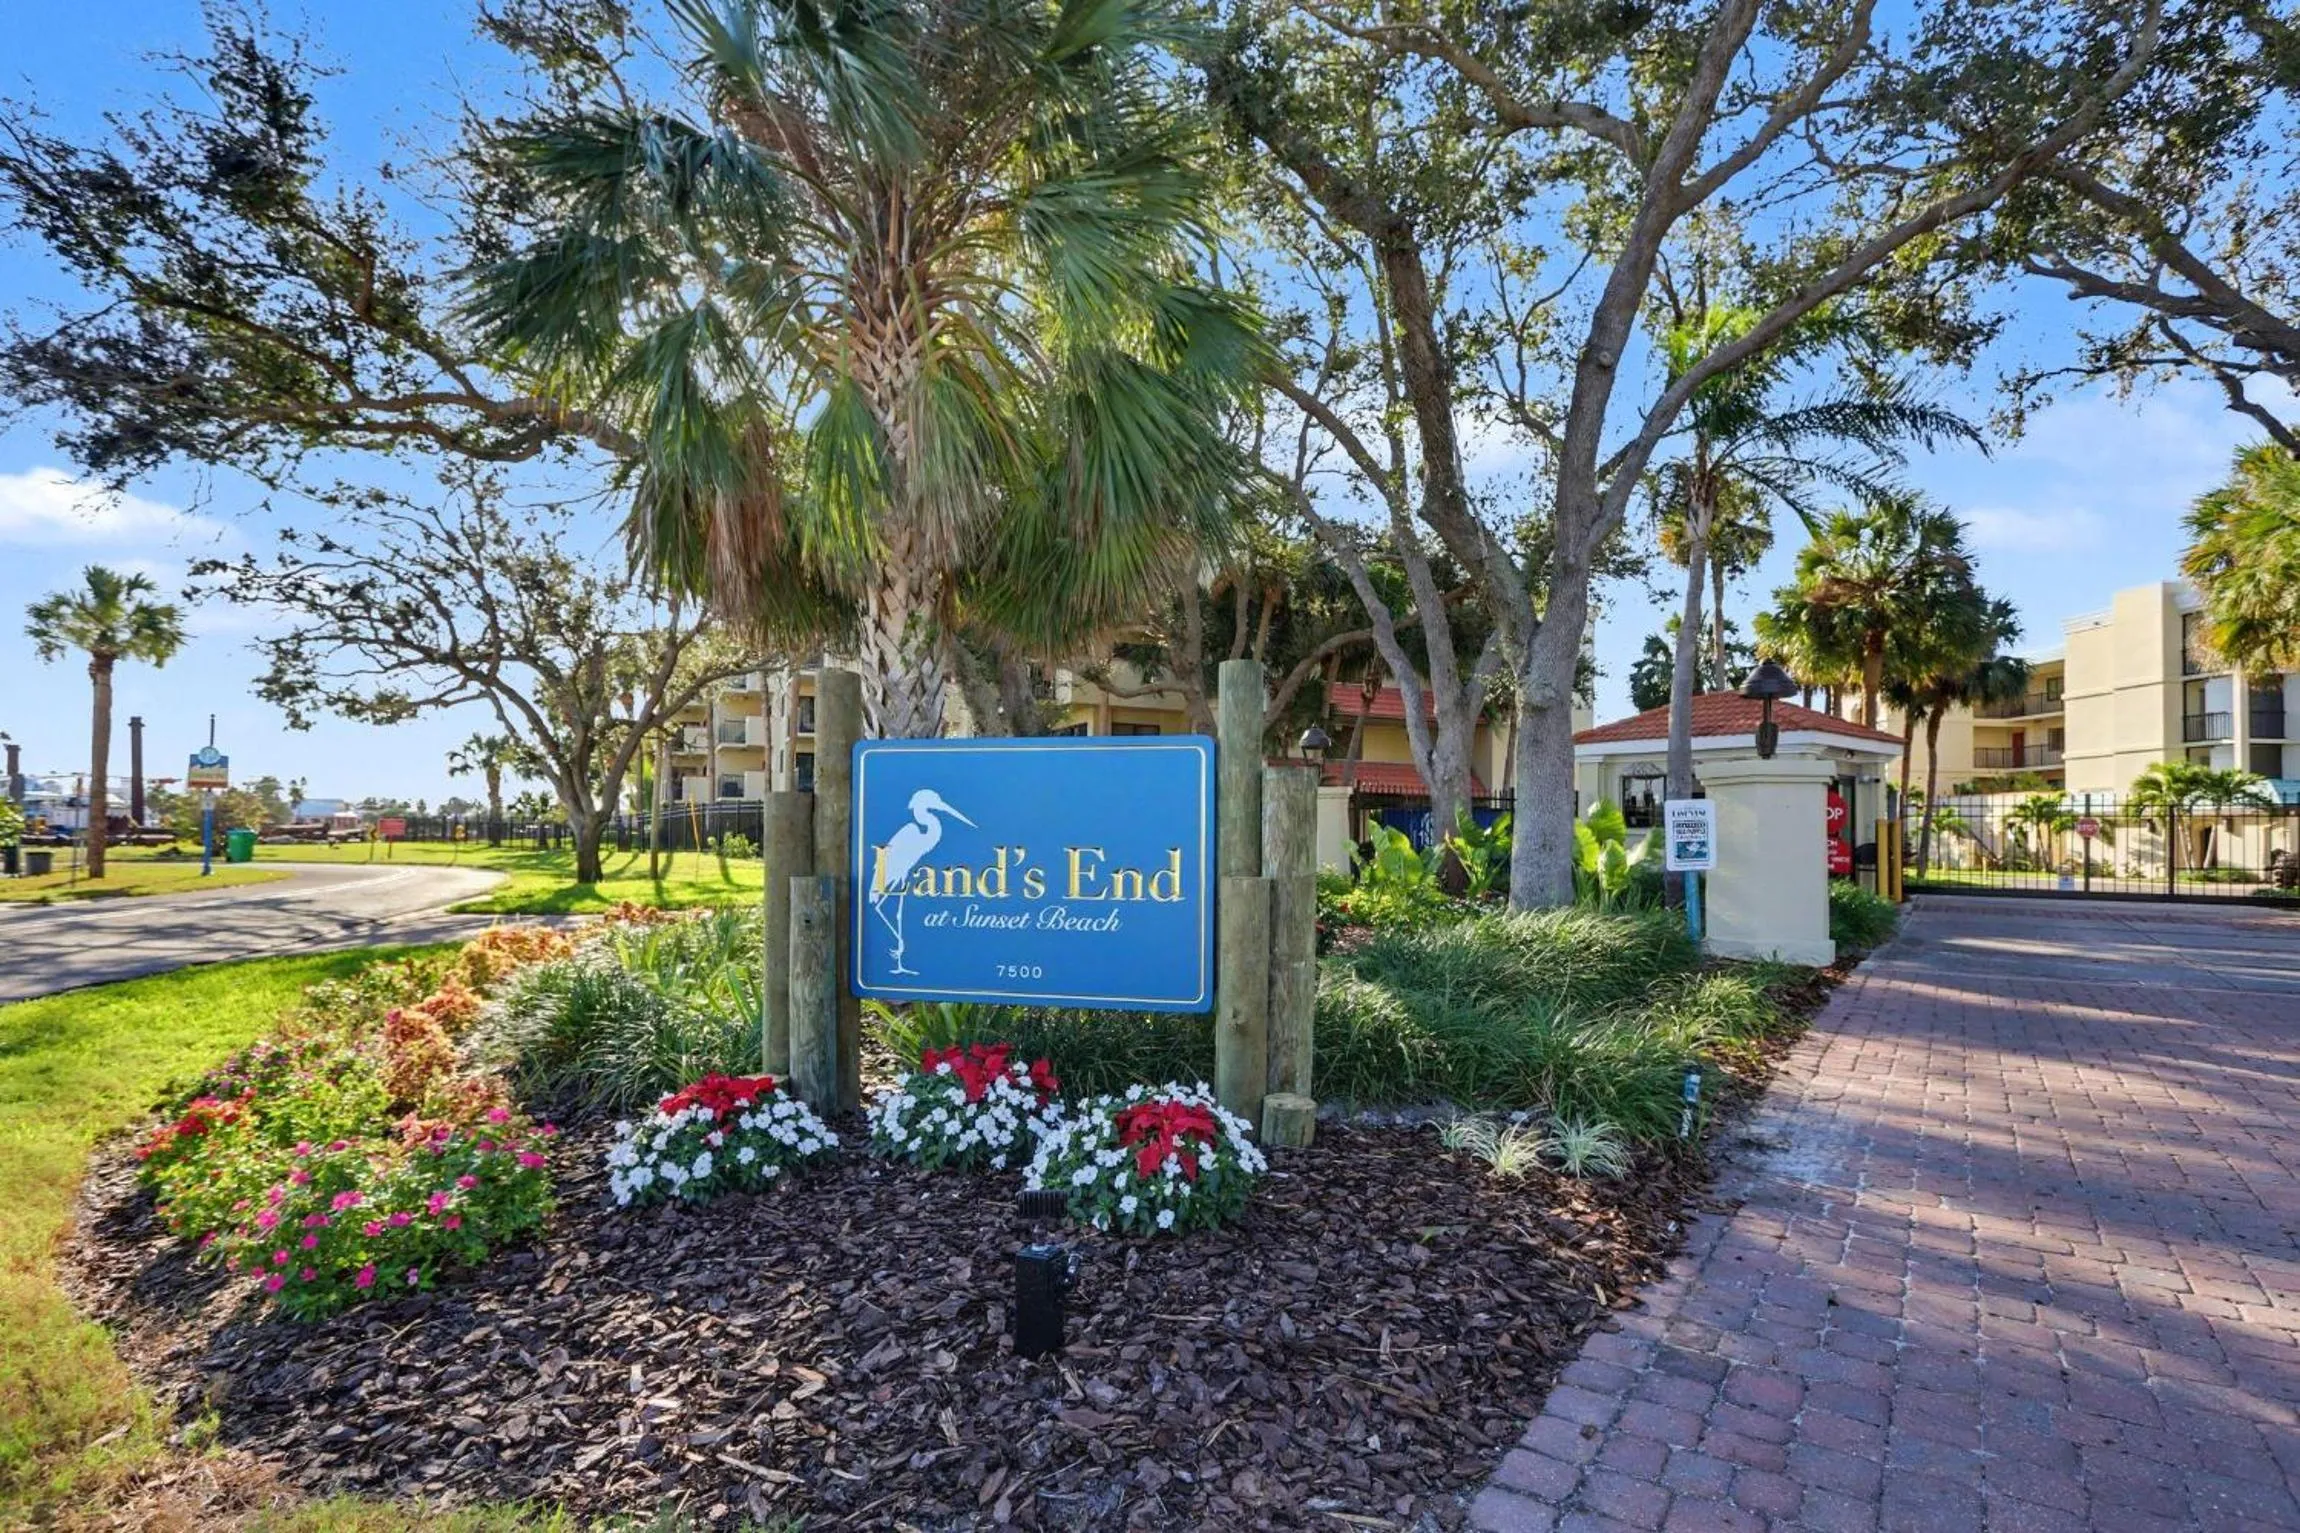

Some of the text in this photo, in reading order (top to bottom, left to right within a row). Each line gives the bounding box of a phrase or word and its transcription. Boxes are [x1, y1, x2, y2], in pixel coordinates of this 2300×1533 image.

[1826, 807, 1844, 820] OP
[871, 845, 1186, 903] Land's End
[924, 903, 1123, 932] at Sunset Beach
[996, 965, 1042, 979] 7500
